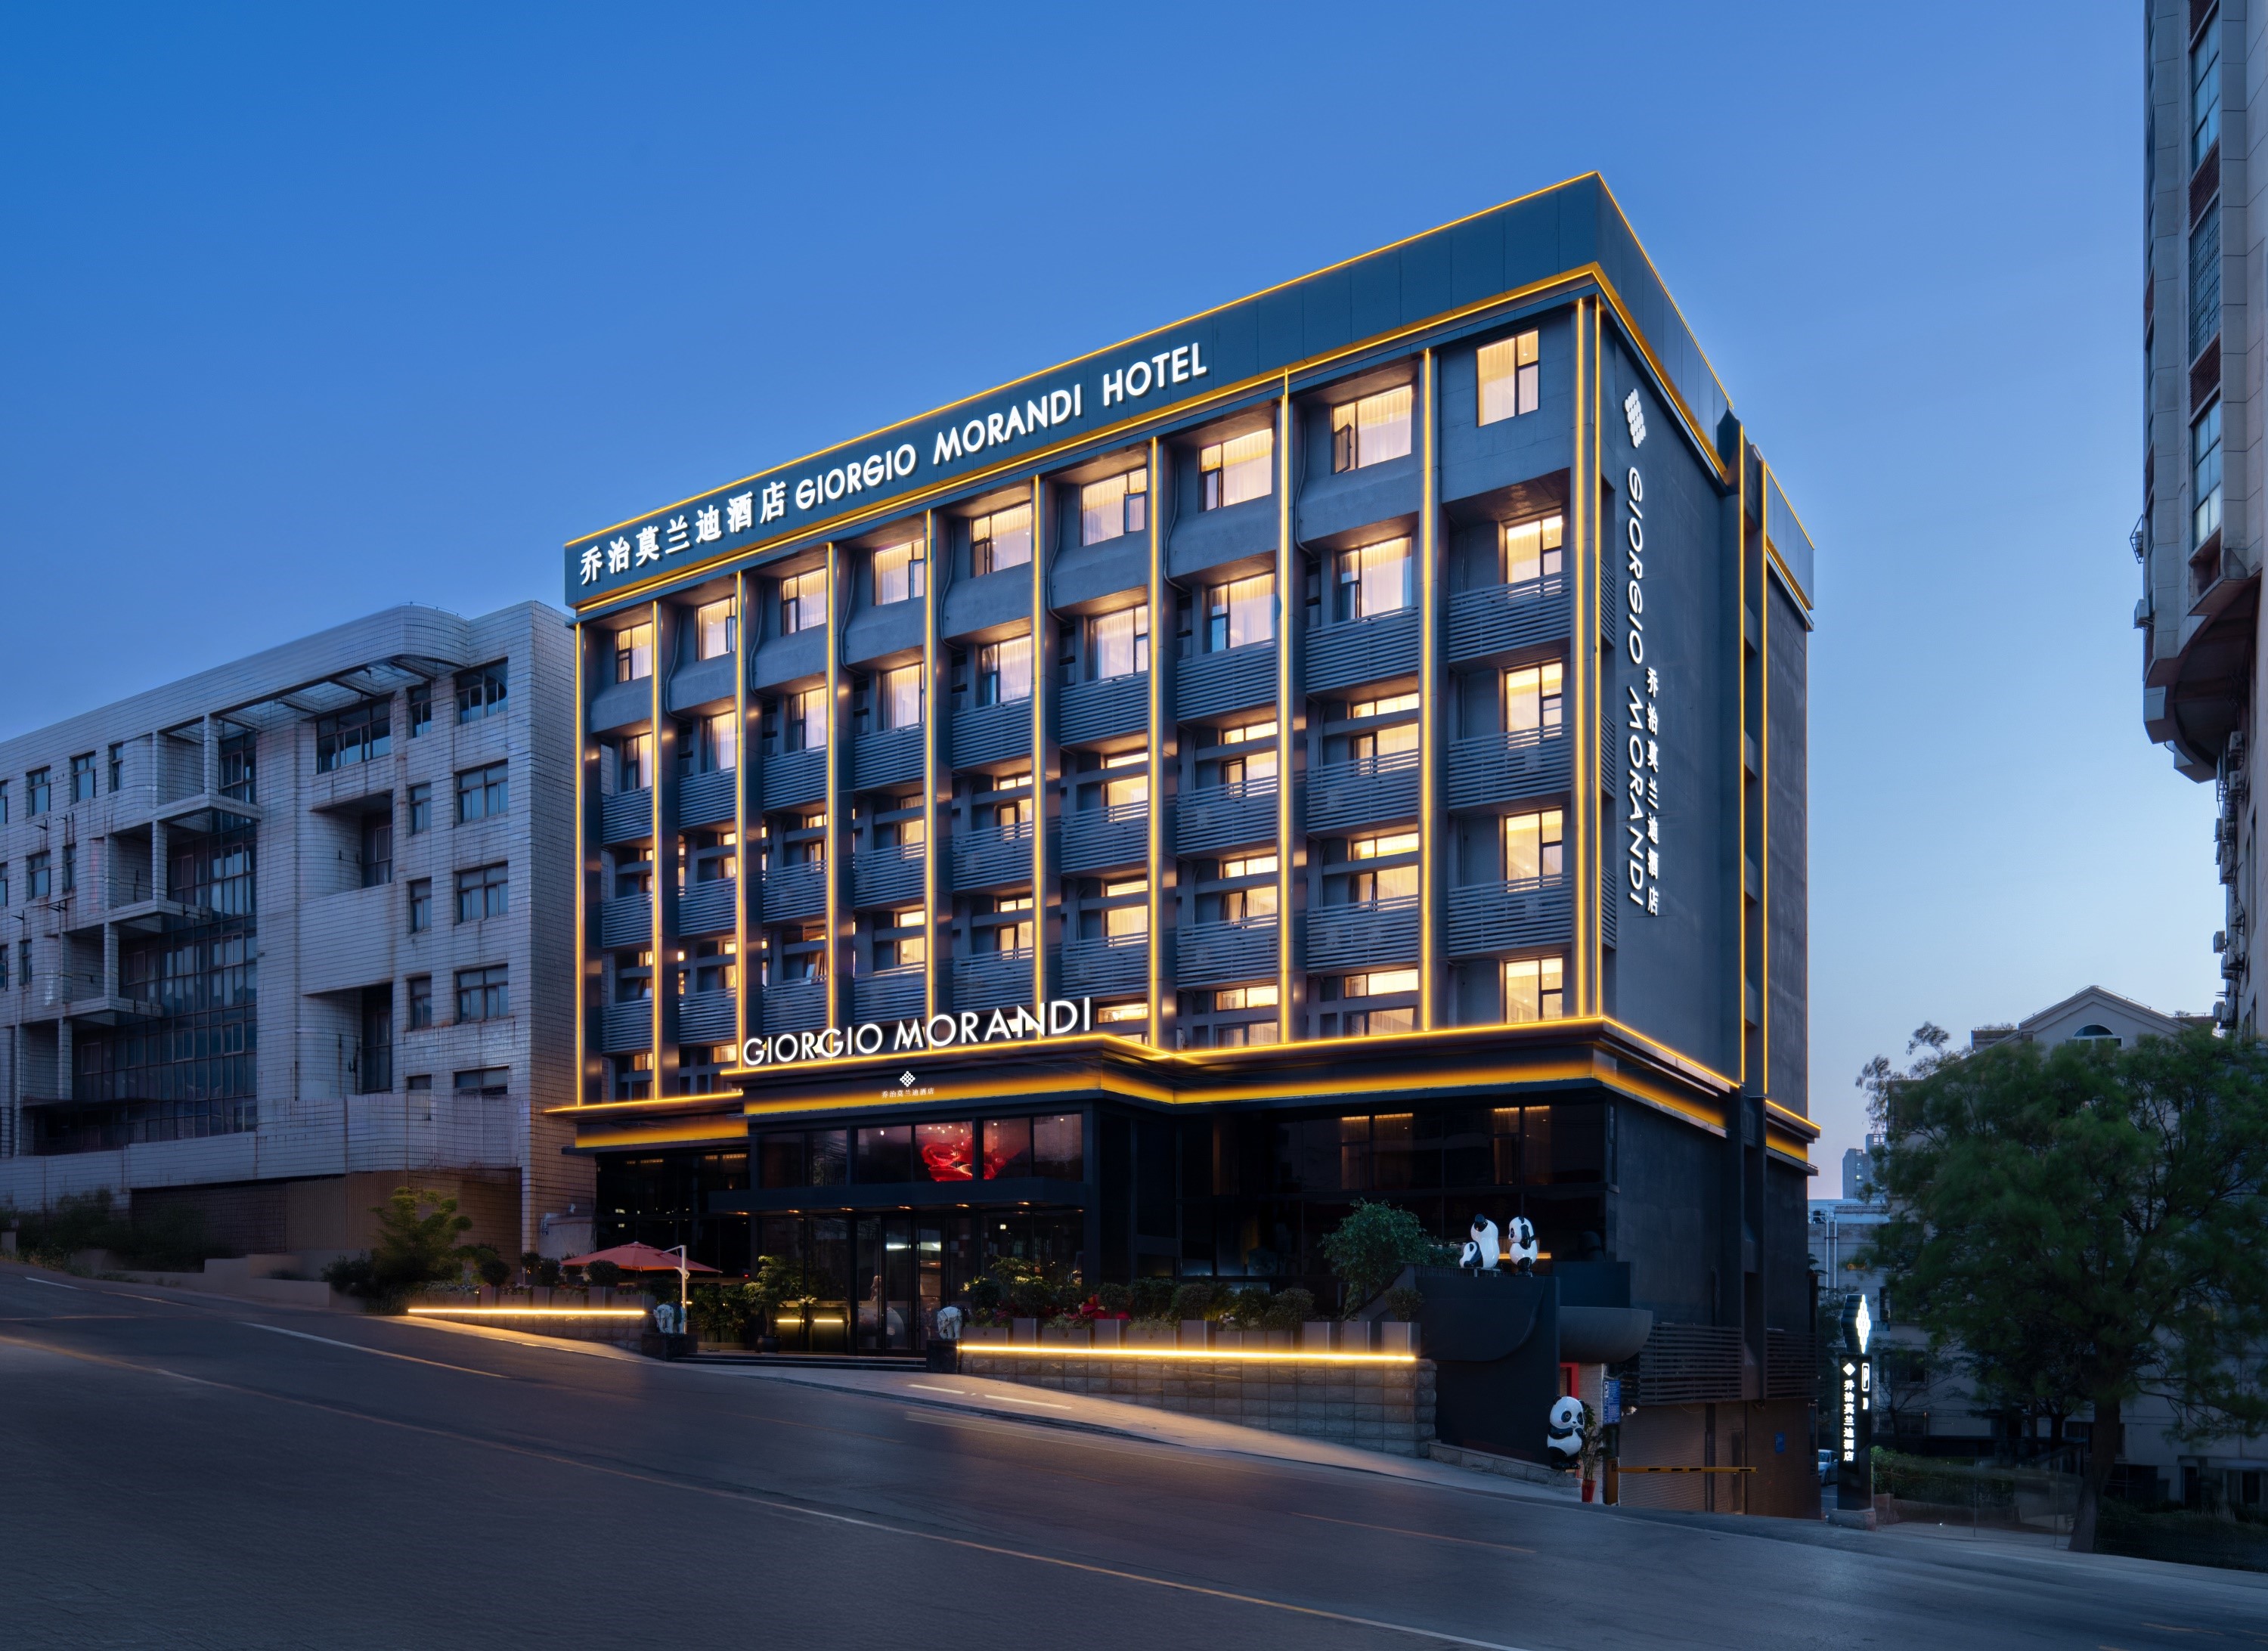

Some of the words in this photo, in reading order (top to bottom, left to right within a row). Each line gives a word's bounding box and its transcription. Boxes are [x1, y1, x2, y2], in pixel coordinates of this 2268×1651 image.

[795, 444, 916, 510] GIORGIO
[933, 383, 1081, 465] MORANDI
[1103, 342, 1207, 406] HOTEL
[580, 481, 786, 585] 乔治莫兰迪酒店
[1628, 466, 1644, 665] GIORGIO
[1628, 686, 1644, 906] MORANDI
[1647, 667, 1659, 917] 乔治莫兰迪酒店
[742, 1023, 883, 1066] GIORGIO
[894, 996, 1091, 1051] MORANDI
[881, 1088, 934, 1098] 乔治莫兰迪酒店
[1843, 1379, 1855, 1462] 乔治莫兰迪酒店
